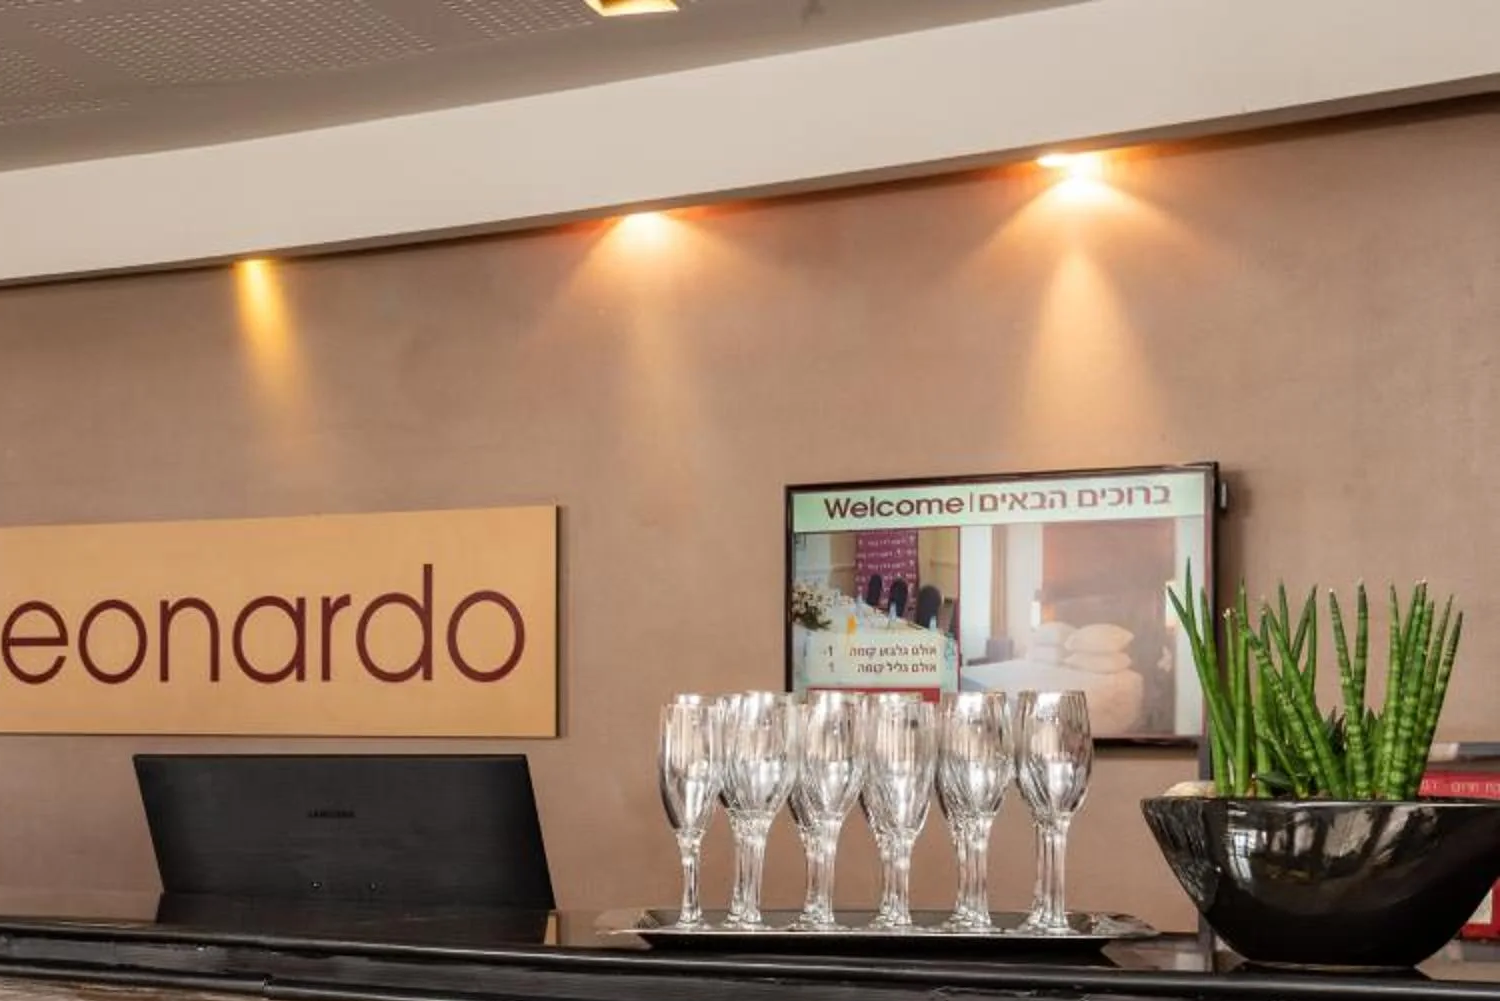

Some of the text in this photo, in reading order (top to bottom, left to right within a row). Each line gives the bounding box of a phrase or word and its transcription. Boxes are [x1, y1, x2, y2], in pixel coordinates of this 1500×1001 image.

[823, 494, 965, 520] Welcome
[979, 485, 1171, 513] ברוכים הבאים
